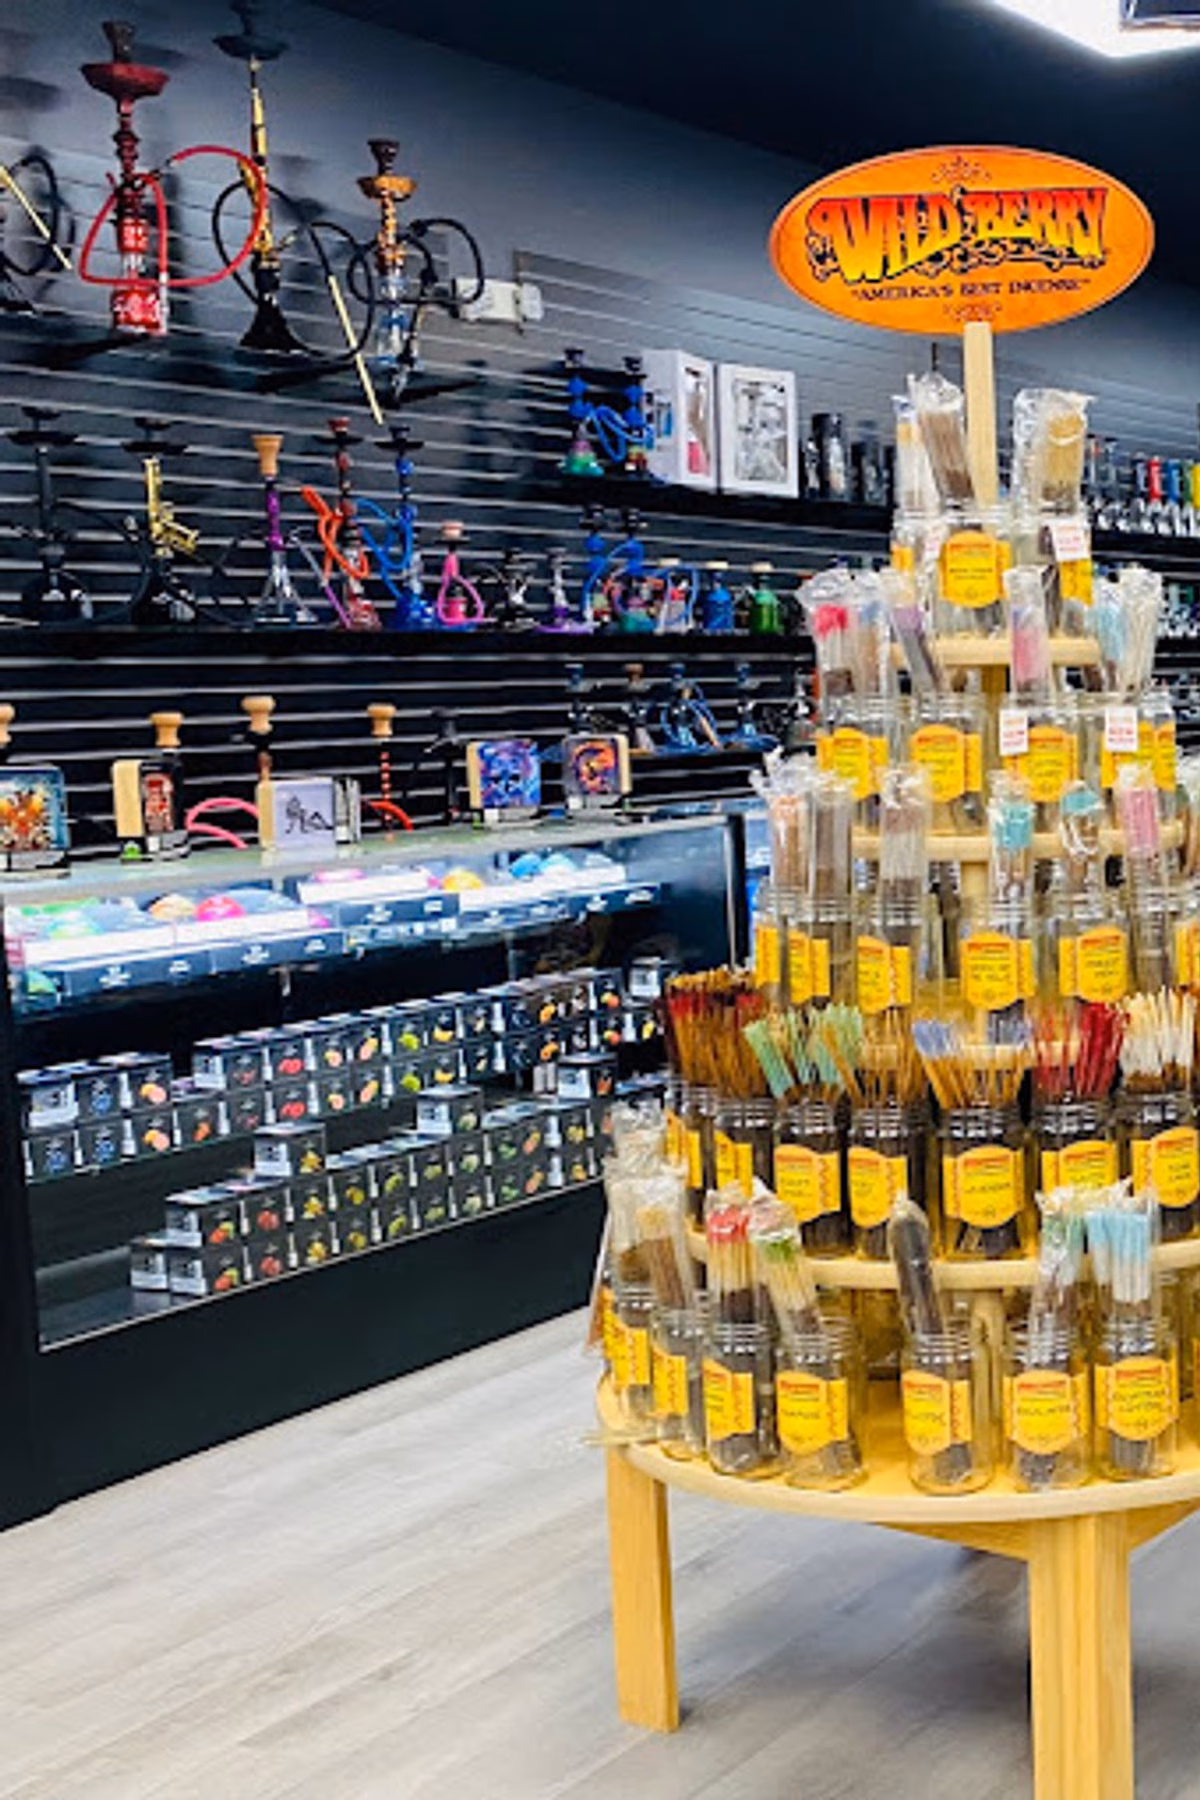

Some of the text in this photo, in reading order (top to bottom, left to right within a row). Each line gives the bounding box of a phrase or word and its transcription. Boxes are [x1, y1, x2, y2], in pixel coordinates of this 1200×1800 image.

[805, 187, 1109, 284] WILD BERRY
[959, 282, 1003, 295] BEST
